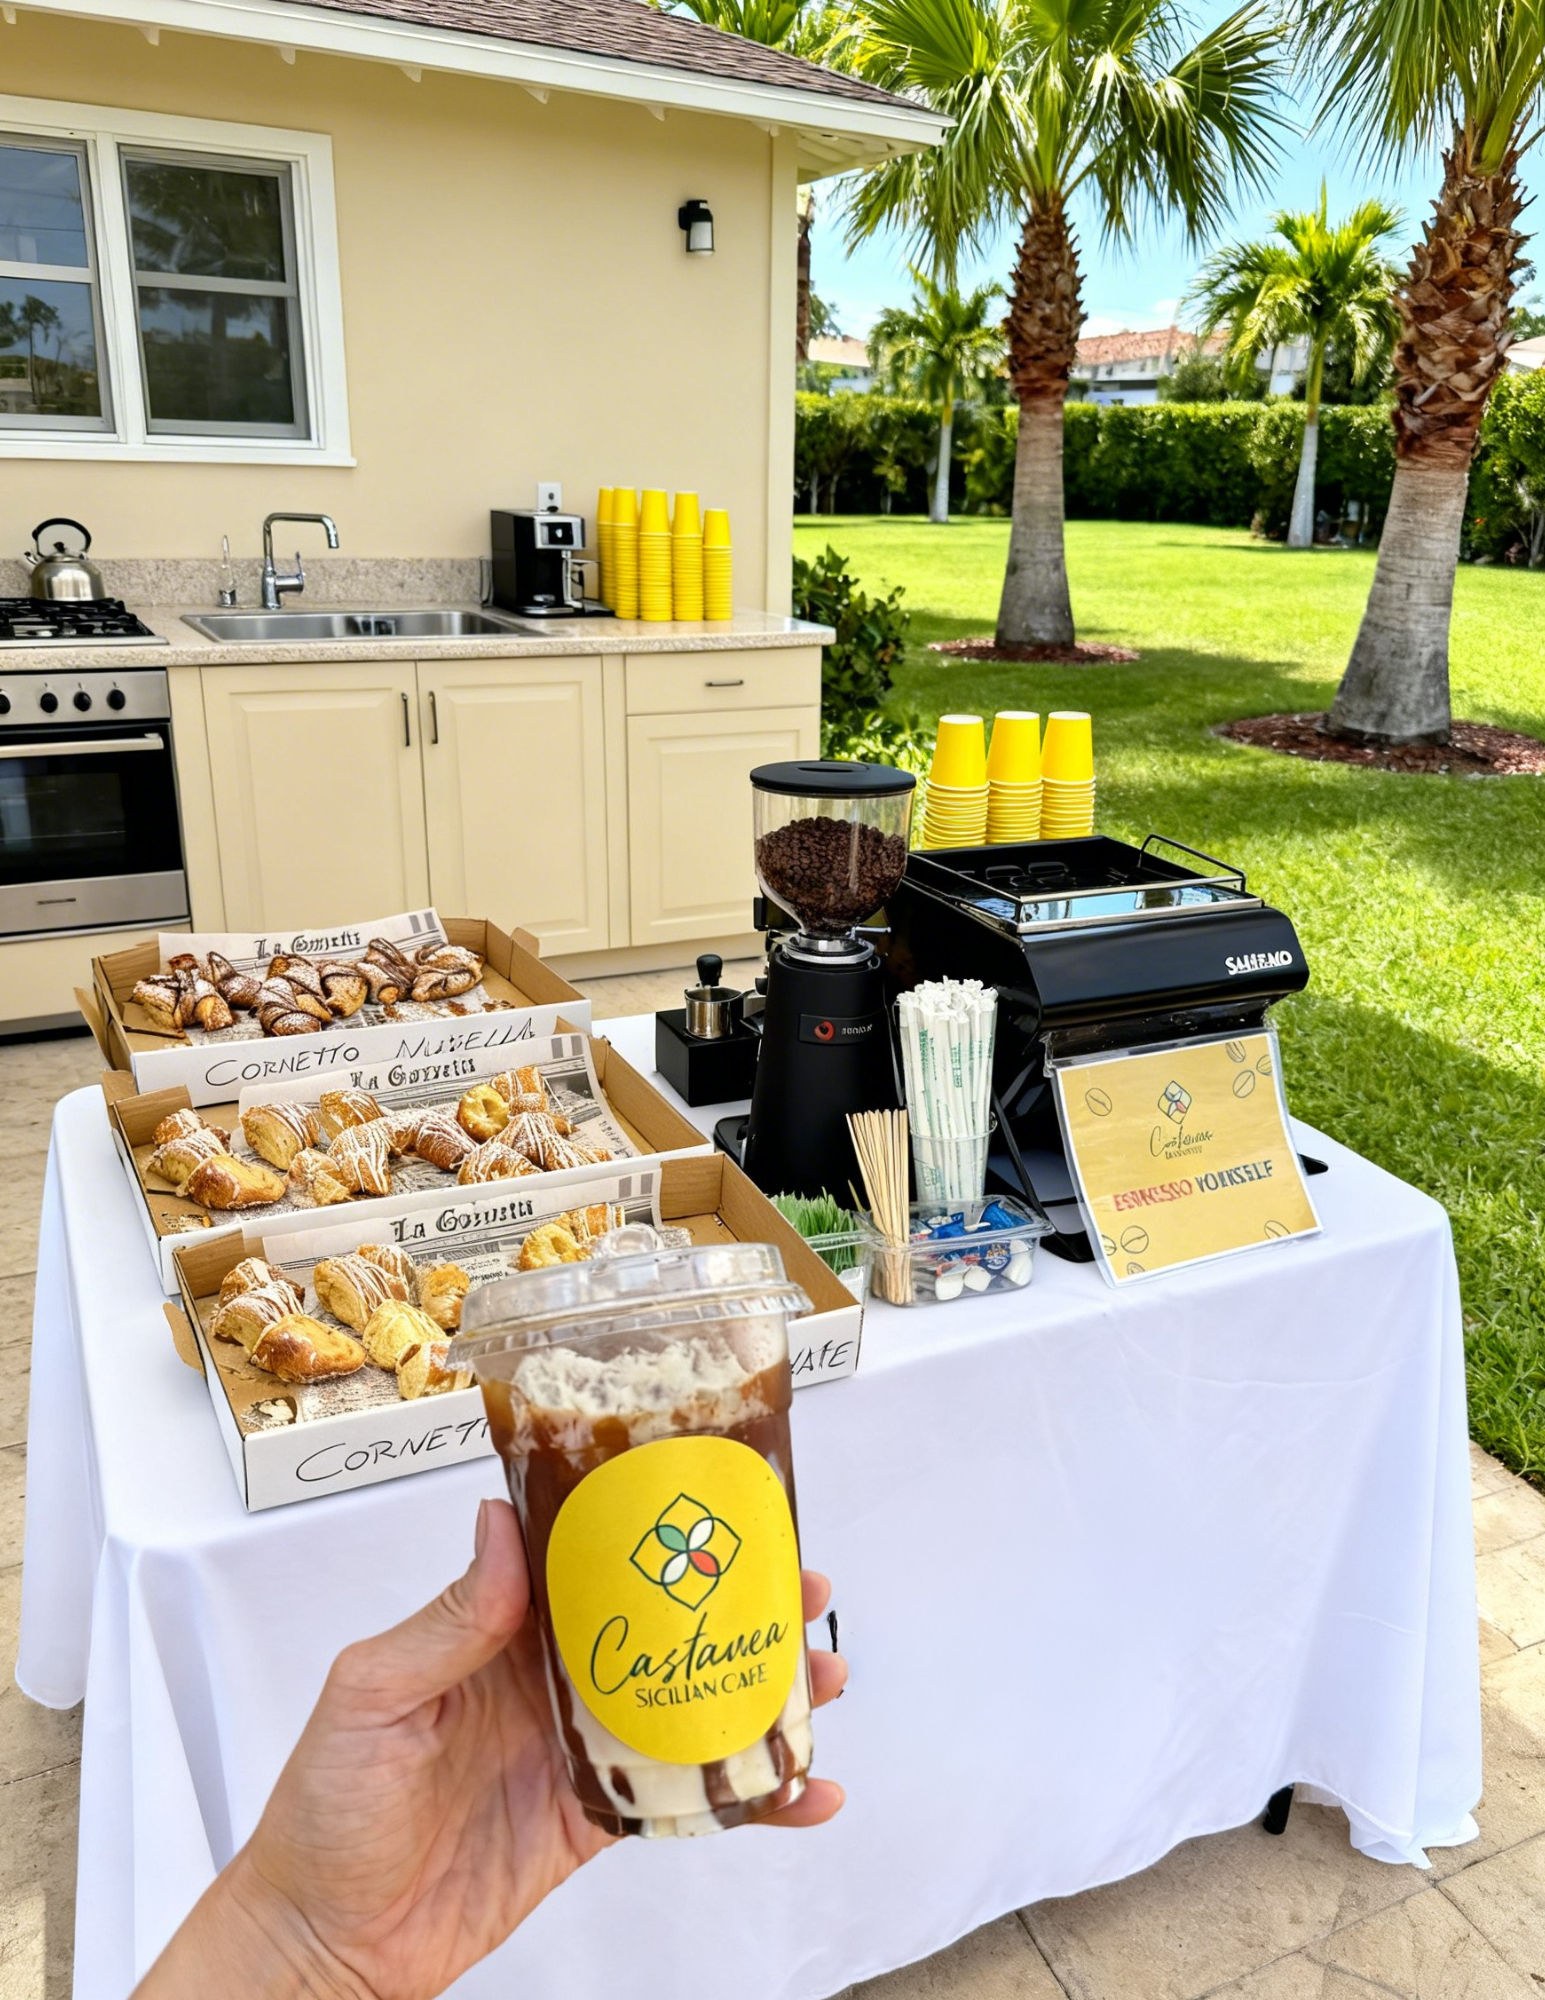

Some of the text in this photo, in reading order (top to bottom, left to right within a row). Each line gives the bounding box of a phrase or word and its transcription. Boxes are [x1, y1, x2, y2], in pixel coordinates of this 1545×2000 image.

[205, 1042, 360, 1088] CORNETTO
[634, 1662, 768, 1708] SICILIAN CAFE
